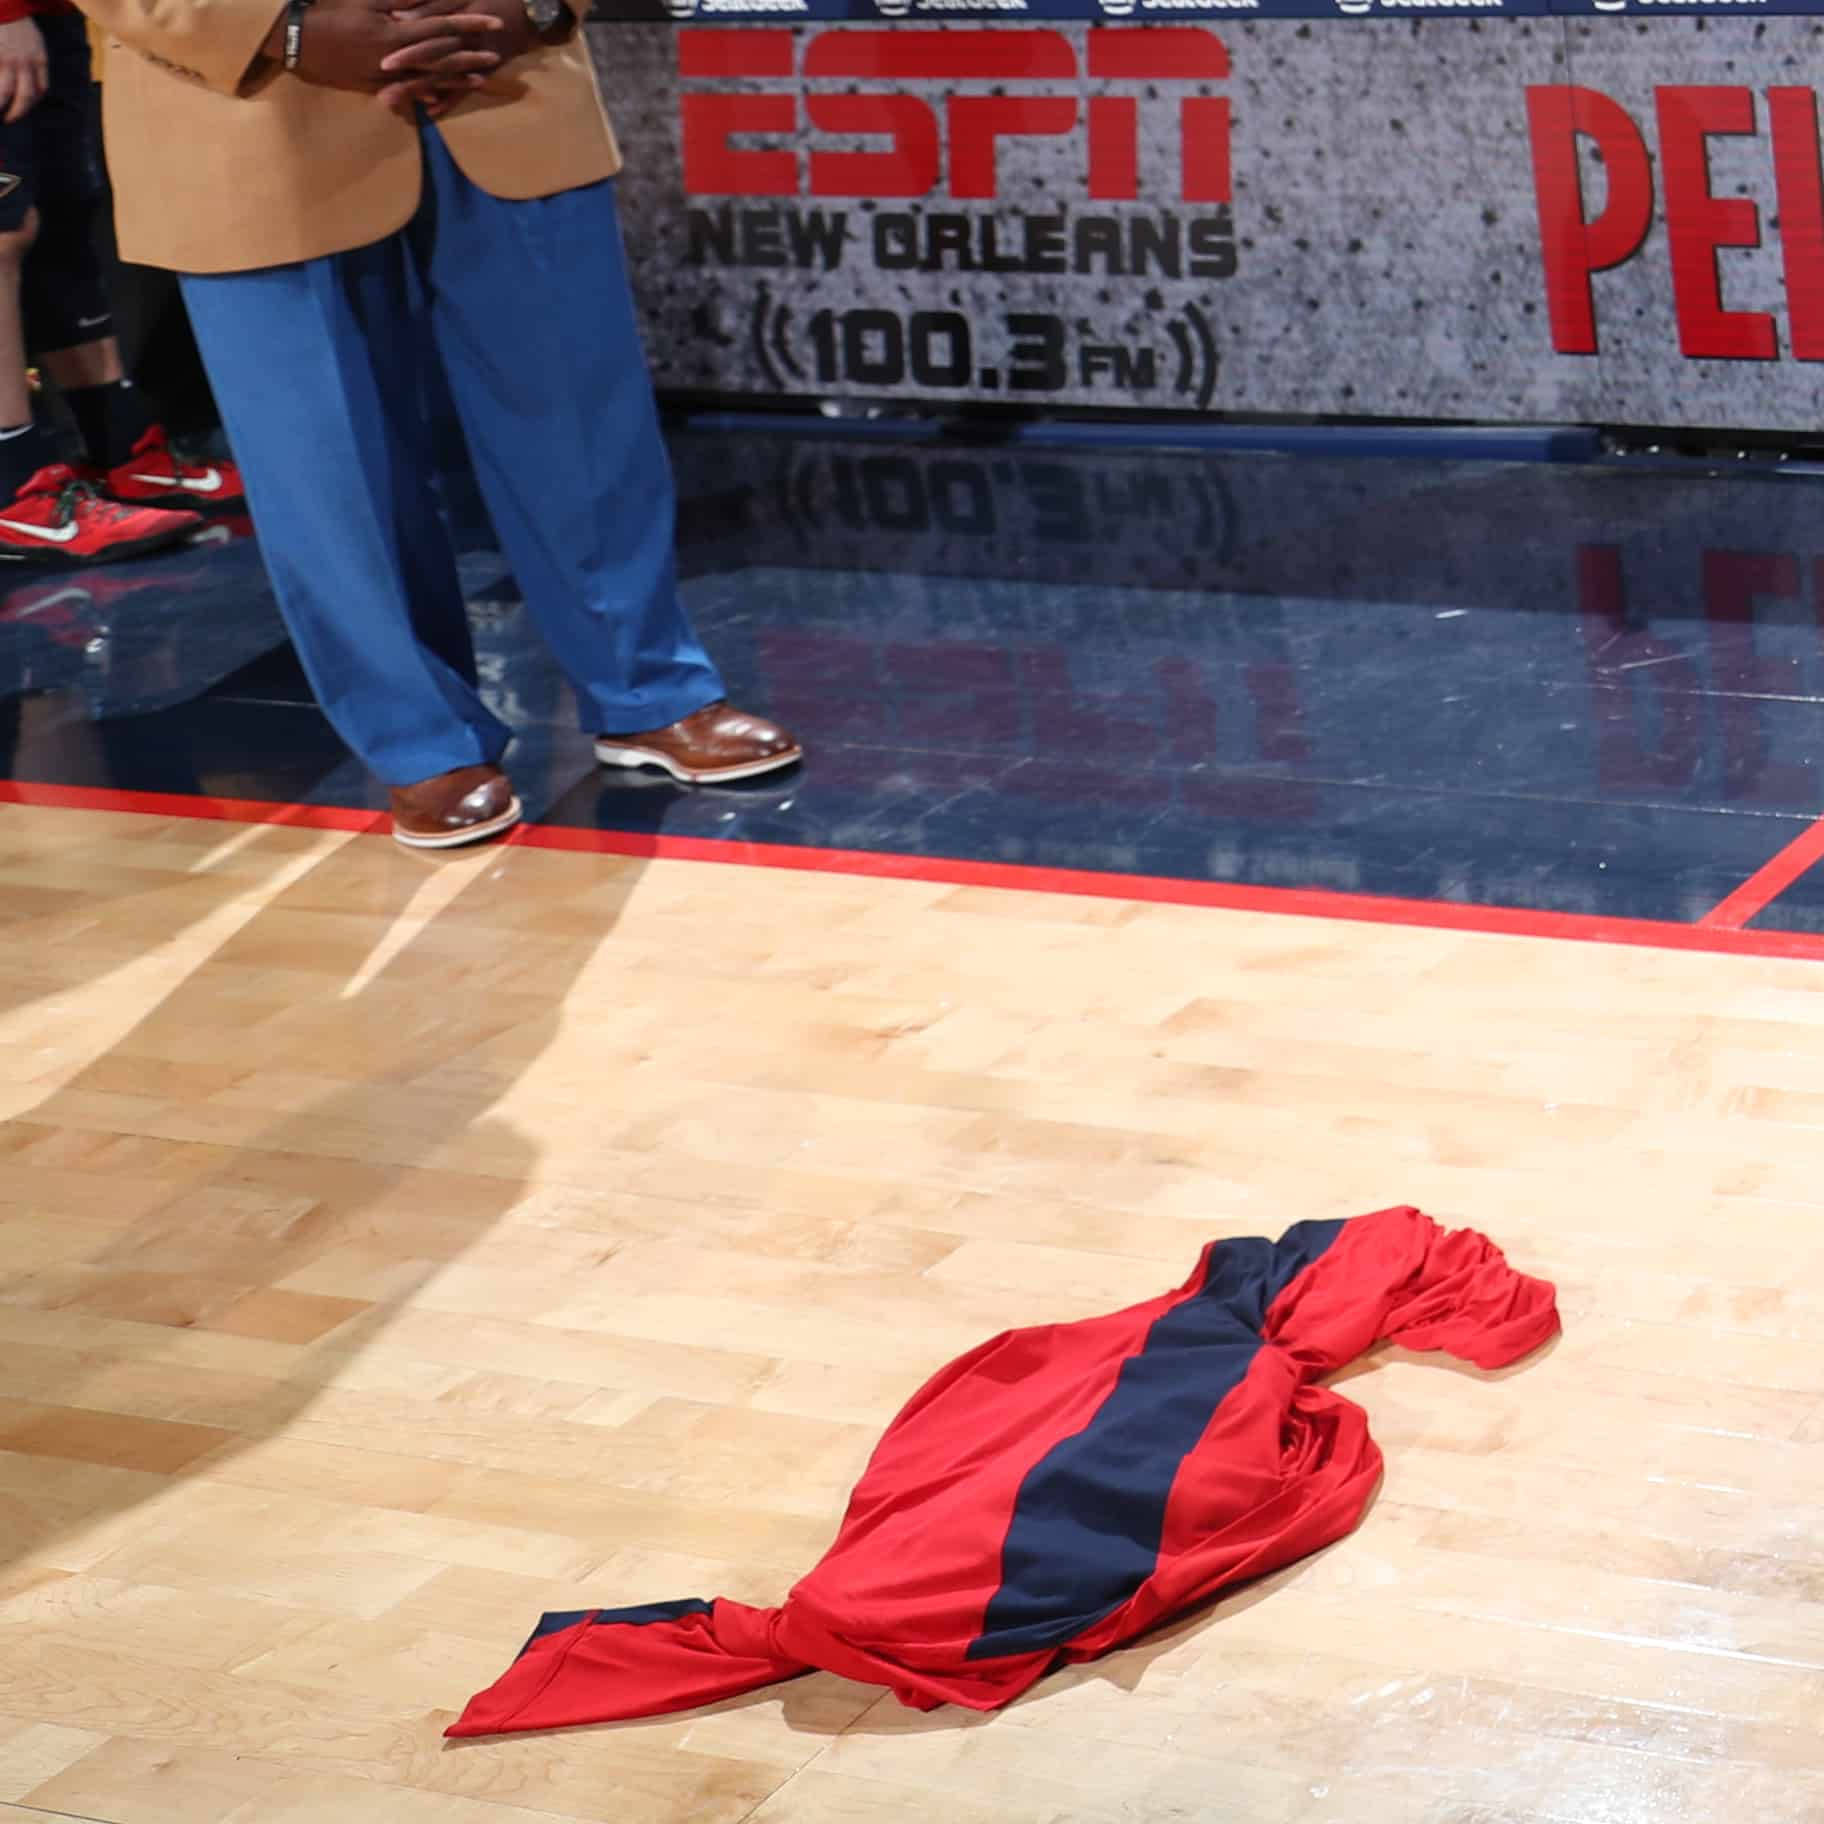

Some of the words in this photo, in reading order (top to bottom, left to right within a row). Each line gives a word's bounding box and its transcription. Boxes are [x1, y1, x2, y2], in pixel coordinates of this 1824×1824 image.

[677, 27, 1233, 203] ESPN
[686, 208, 849, 270] NEW
[872, 212, 1239, 278] ORLEANS
[806, 308, 1067, 392] 100.3
[1075, 343, 1157, 389] FM
